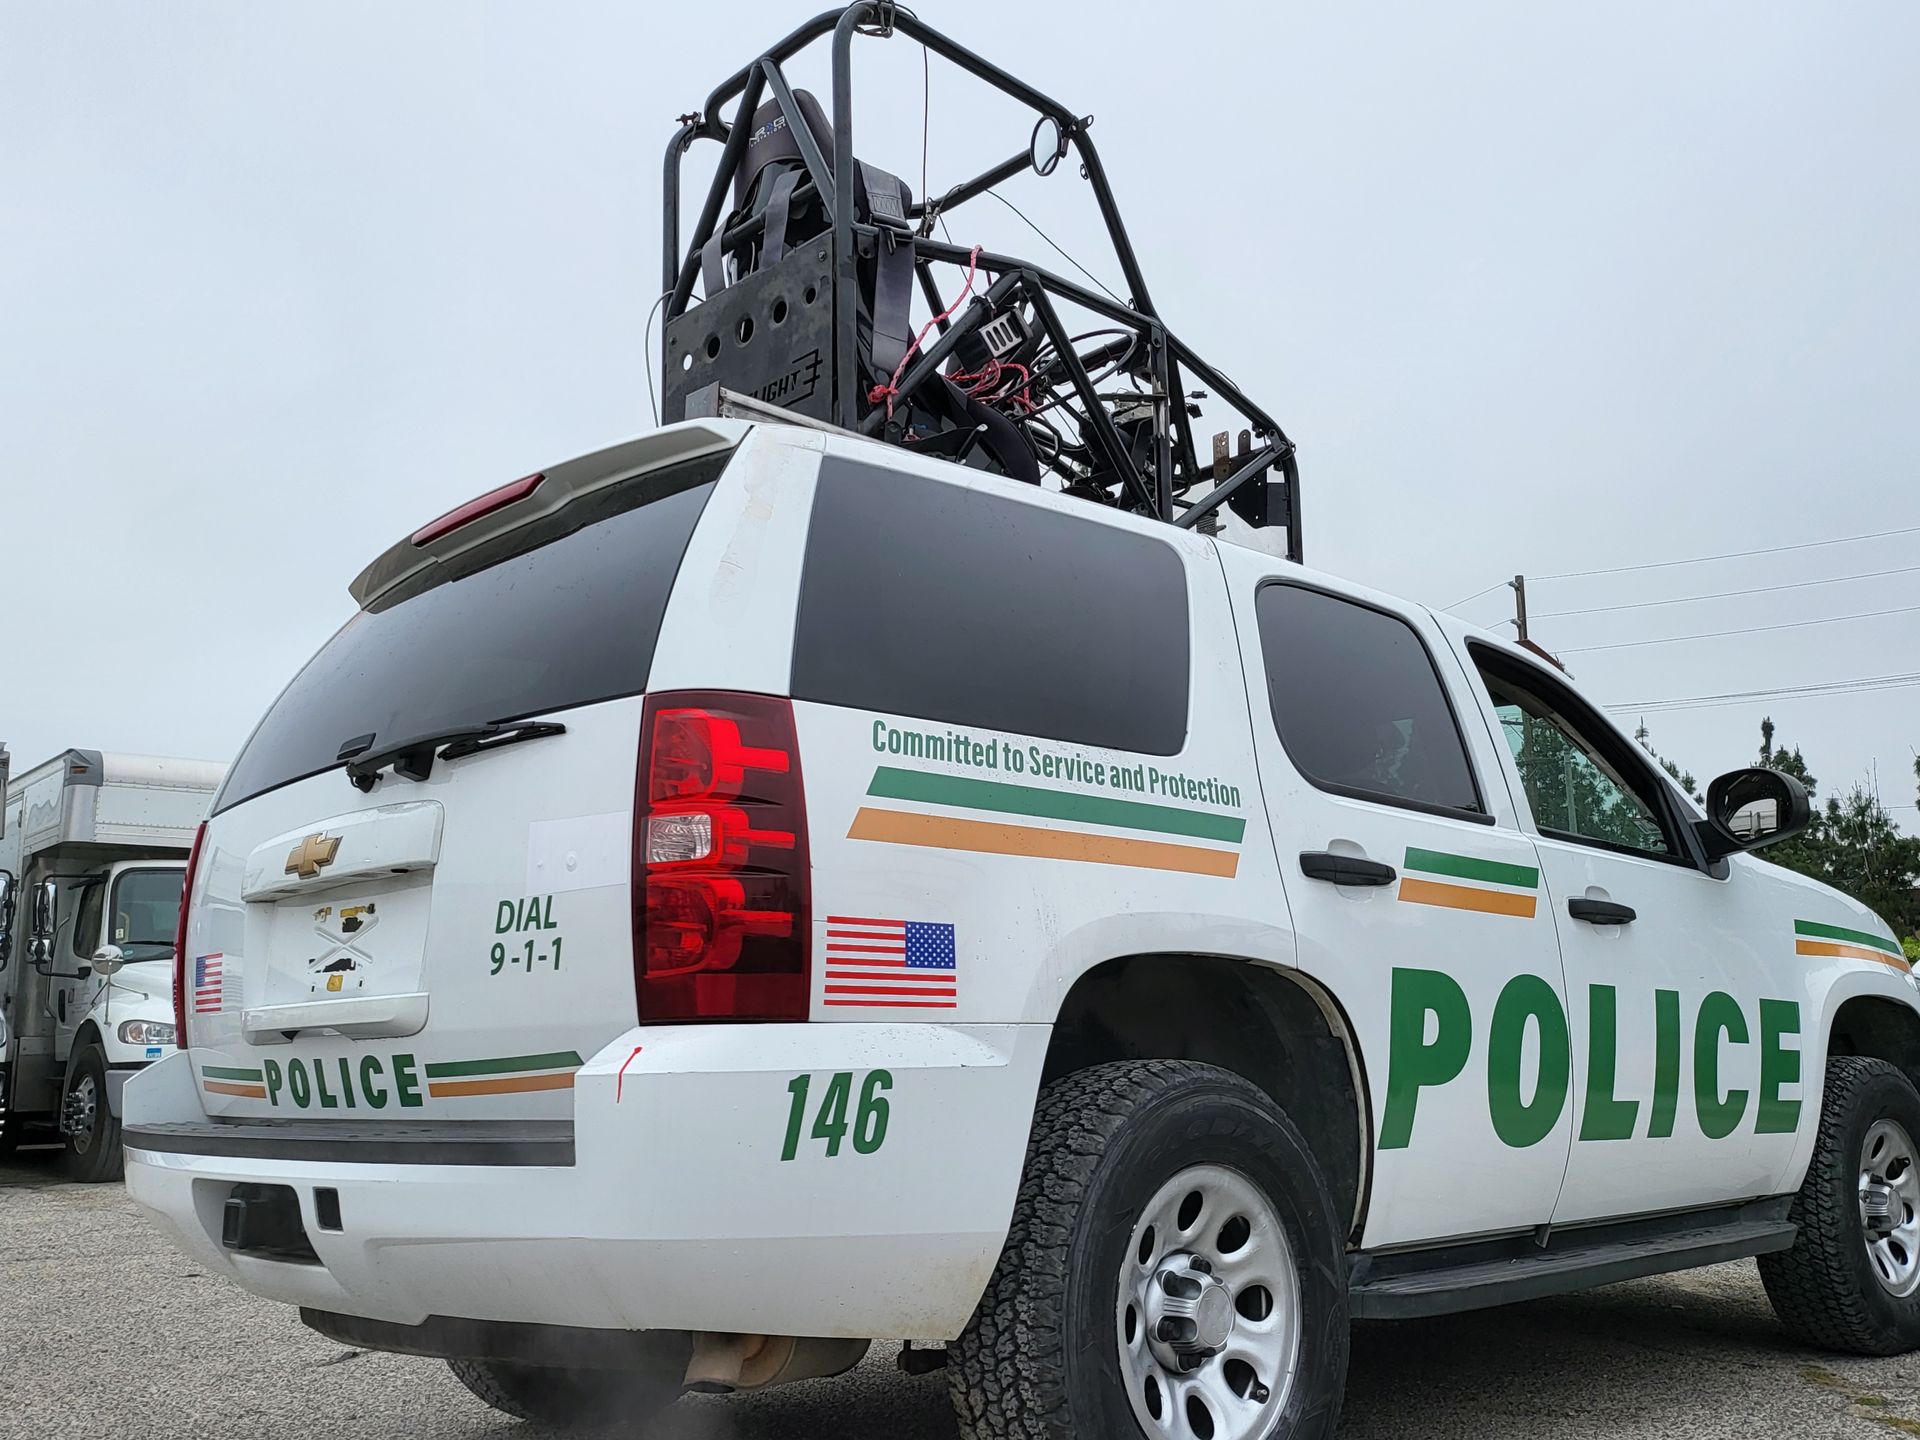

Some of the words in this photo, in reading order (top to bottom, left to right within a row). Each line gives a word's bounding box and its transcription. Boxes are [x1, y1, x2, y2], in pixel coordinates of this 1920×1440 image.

[872, 720, 998, 769] Committed
[1003, 742, 1025, 773] to
[1029, 745, 1105, 786] Service
[1110, 764, 1145, 793] and
[1148, 767, 1242, 808] Protection
[495, 895, 557, 934] DIAL
[490, 937, 562, 976] 9-1-1
[264, 1053, 423, 1110] POLICE
[1376, 966, 1803, 1151] POLICE
[780, 1068, 893, 1162] 146
